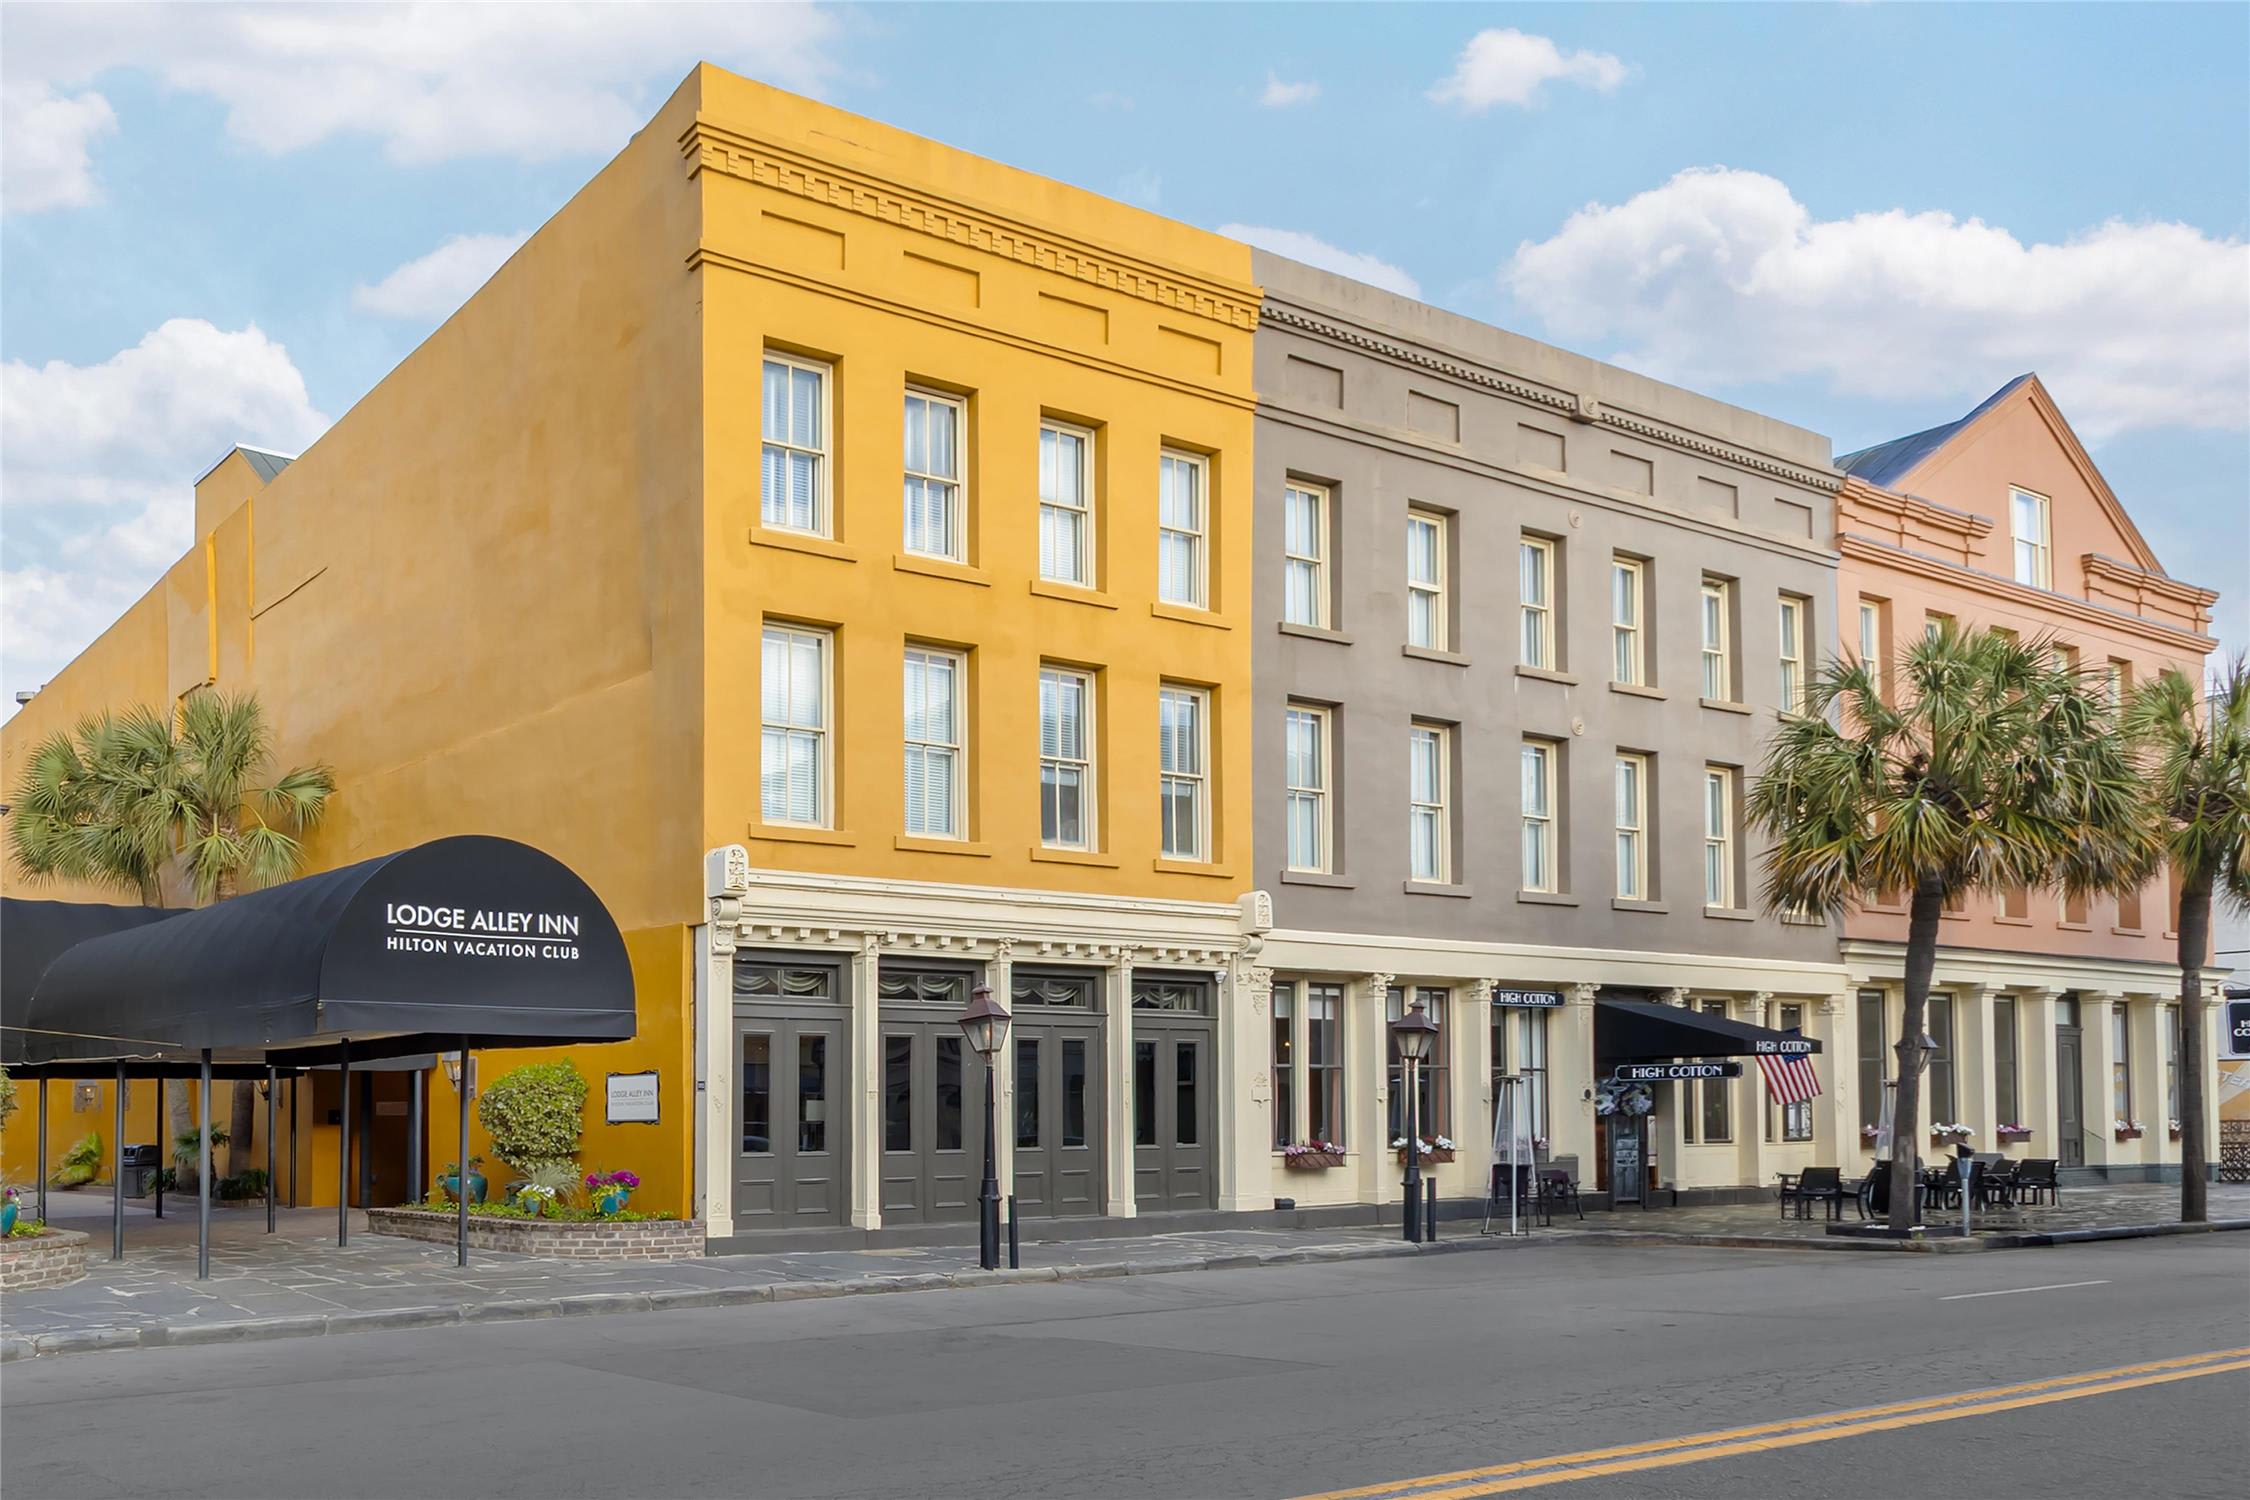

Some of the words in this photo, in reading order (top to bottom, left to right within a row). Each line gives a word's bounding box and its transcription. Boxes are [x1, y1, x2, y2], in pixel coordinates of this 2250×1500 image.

[387, 903, 465, 929] LODGE
[471, 910, 533, 933] ALLEY
[538, 914, 579, 936] INN
[387, 937, 447, 953] HILTON
[454, 941, 536, 957] VACATION
[542, 946, 579, 959] CLUB
[1500, 992, 1521, 1004] HIGH
[1523, 993, 1556, 1005] COTTON
[1756, 1041, 1777, 1052] HIGH
[1780, 1041, 1811, 1053] COTTON
[1632, 1067, 1664, 1078] HIGH
[1669, 1065, 1723, 1077] COTTON
